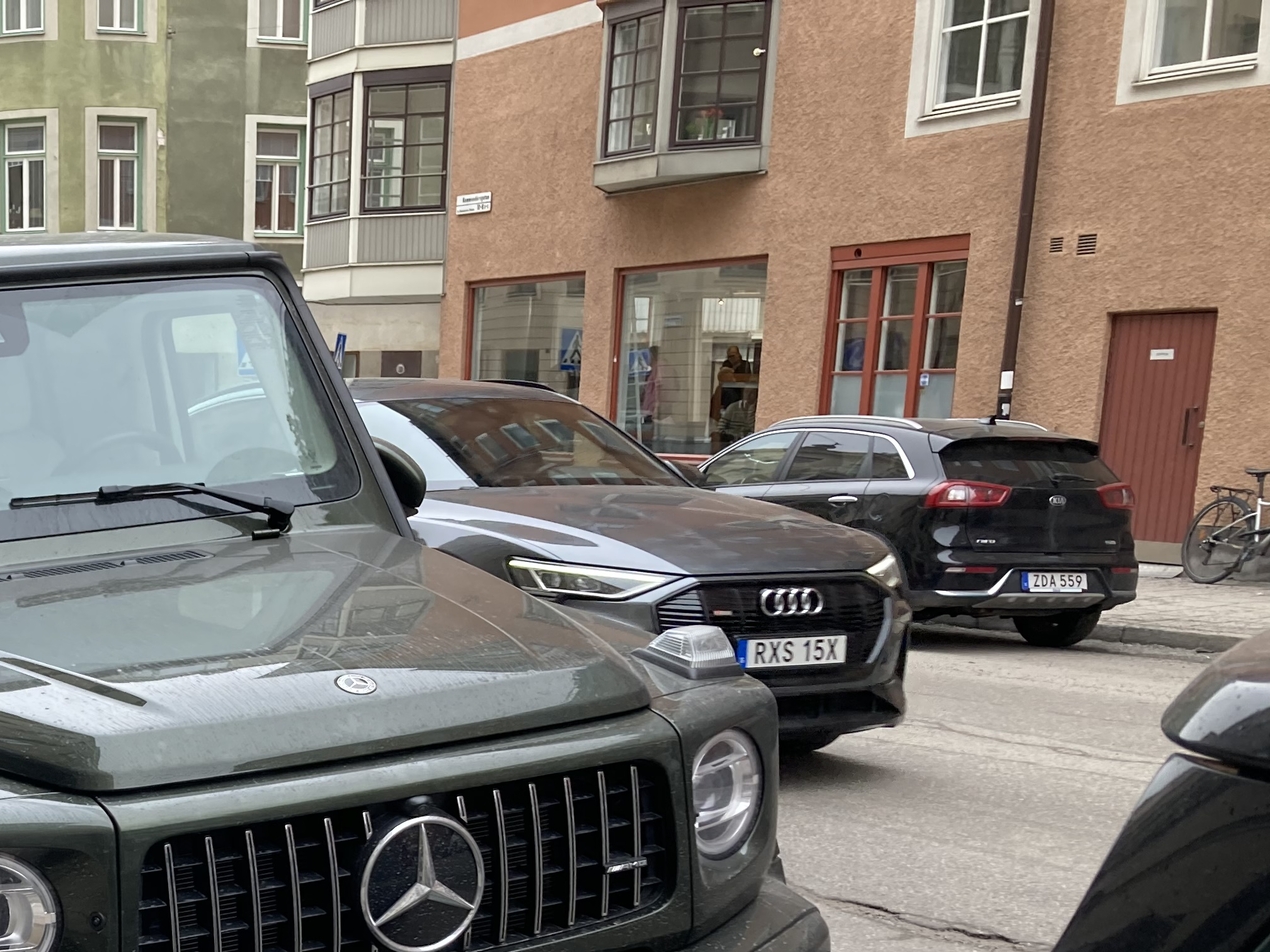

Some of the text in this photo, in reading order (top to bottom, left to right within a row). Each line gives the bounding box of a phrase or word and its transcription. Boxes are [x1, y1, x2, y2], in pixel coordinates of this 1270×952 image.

[1033, 574, 1083, 587] ZDA 559
[754, 638, 838, 664] RXS 15X
